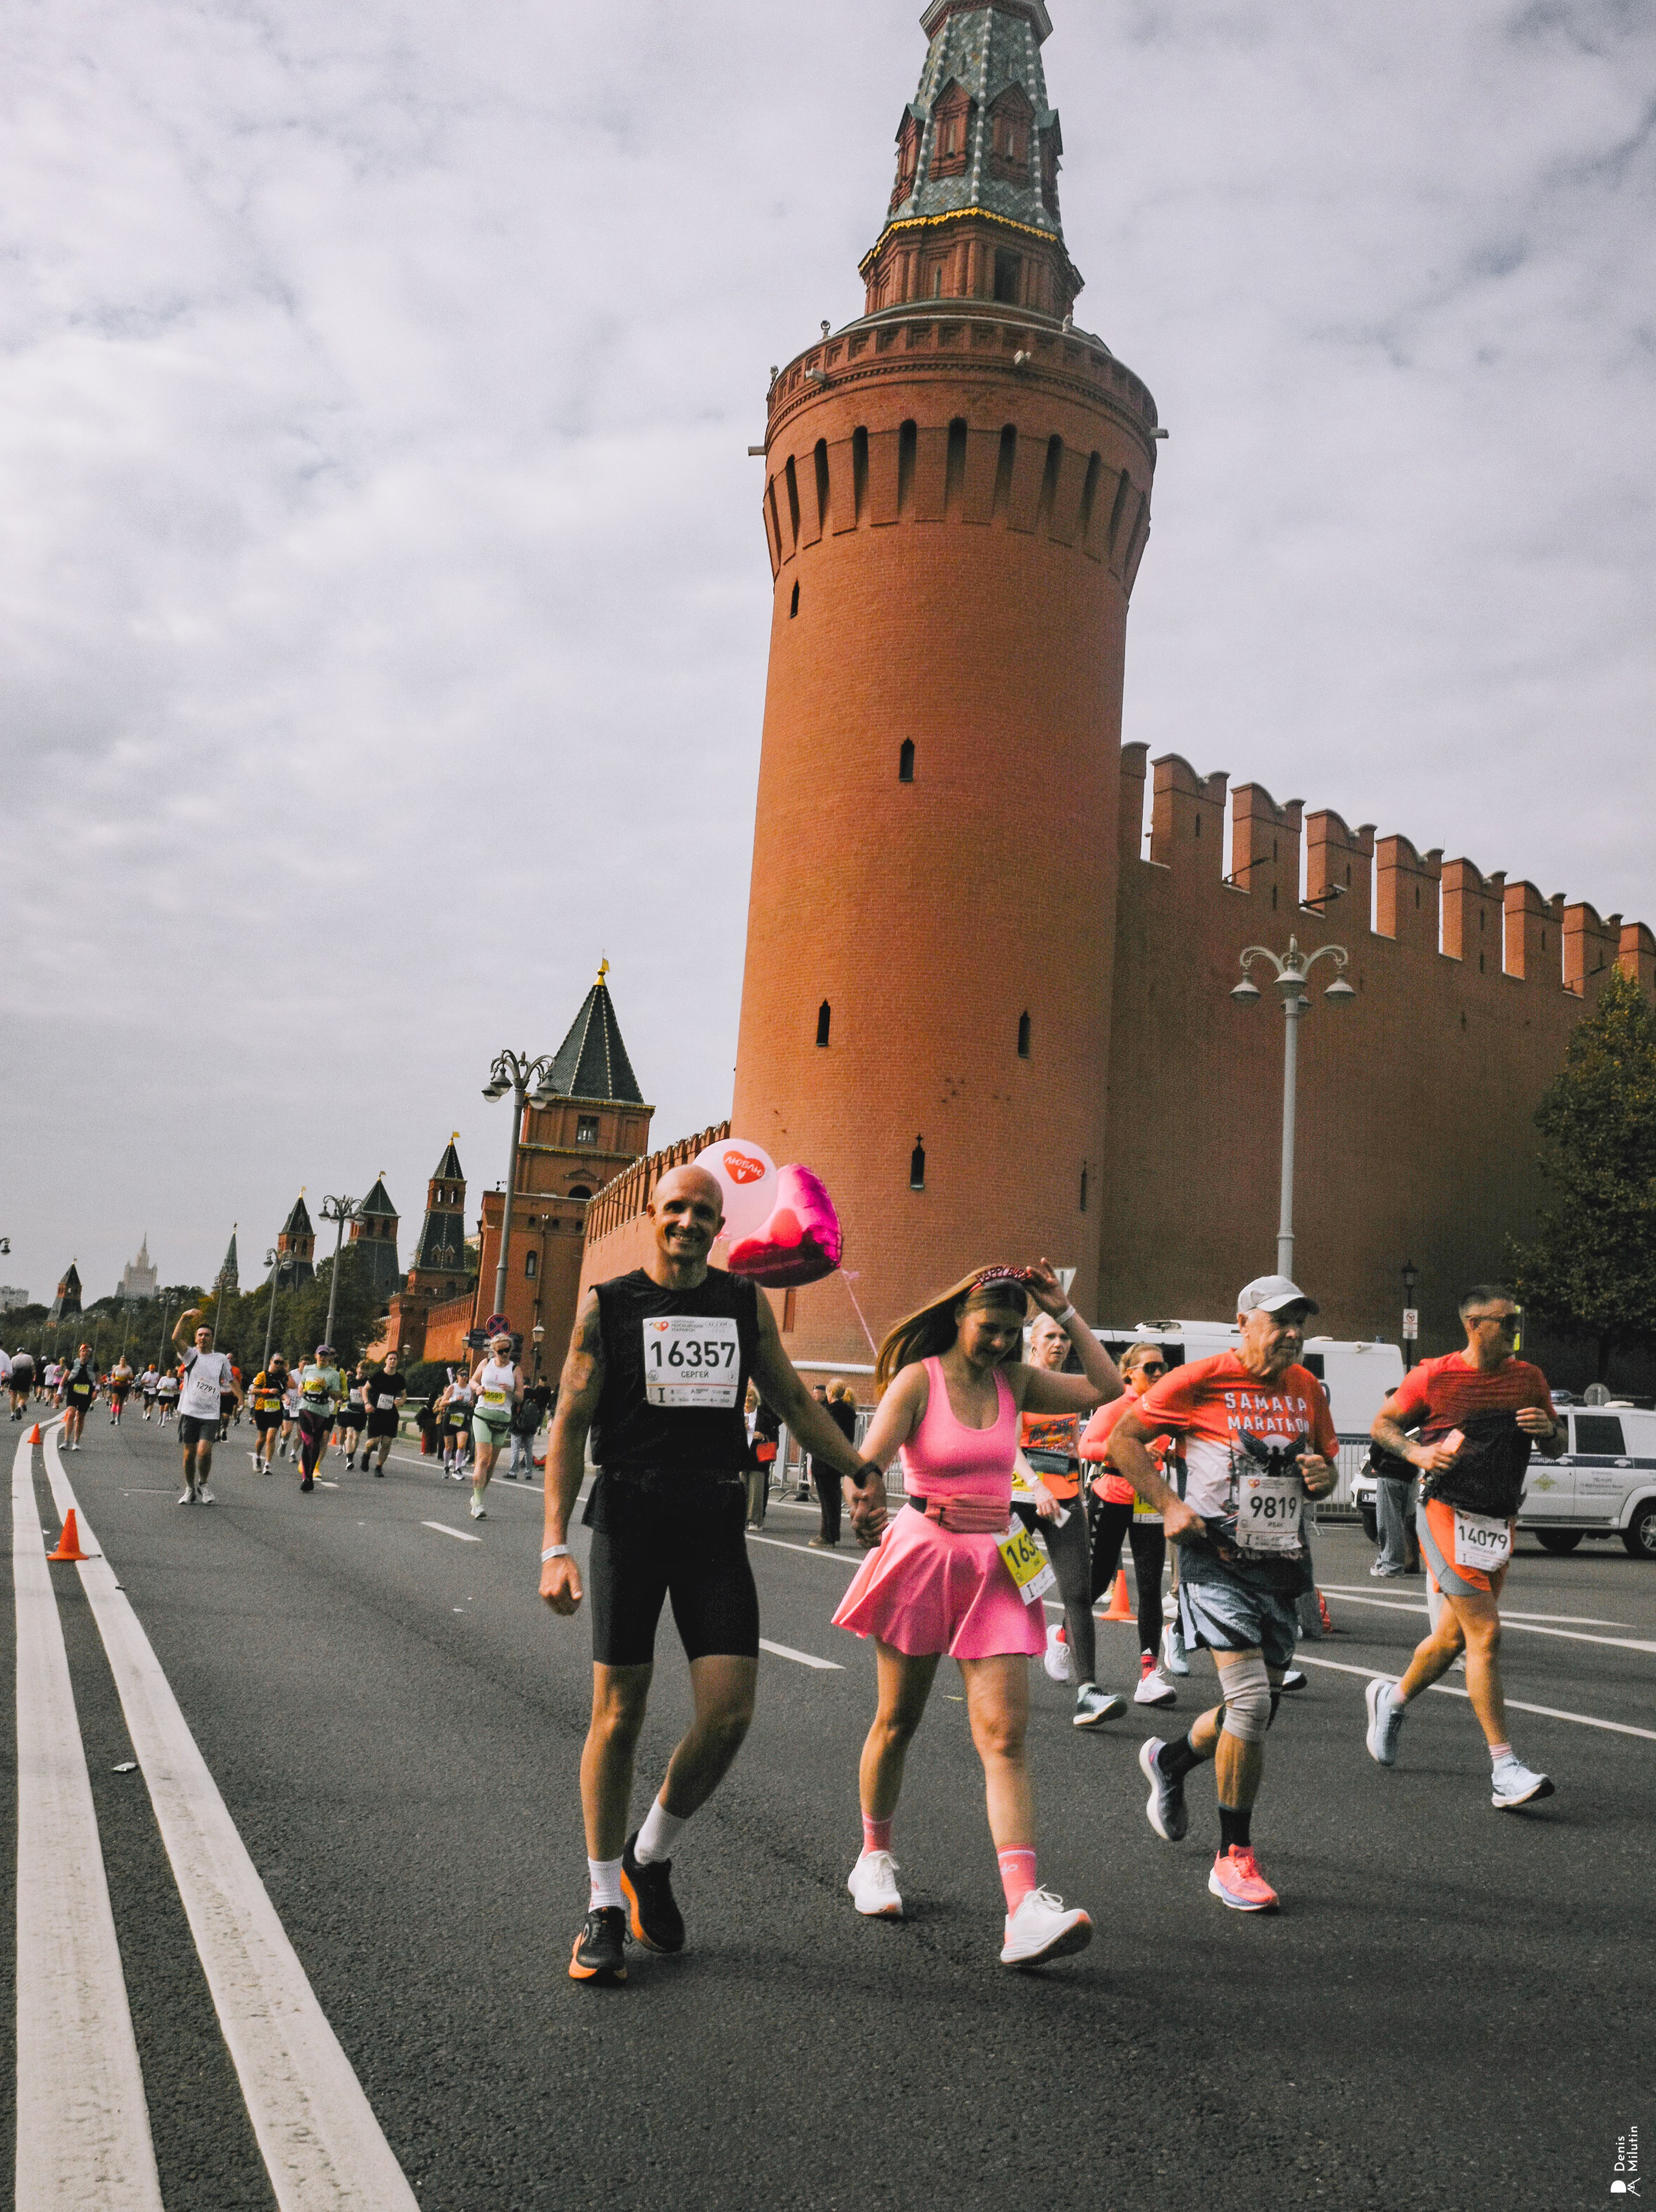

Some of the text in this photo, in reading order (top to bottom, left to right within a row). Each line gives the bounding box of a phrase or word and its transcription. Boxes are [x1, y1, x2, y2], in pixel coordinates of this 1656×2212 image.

[724, 1155, 763, 1177] ЛЮБЛЮ
[975, 1265, 1007, 1284] HAPPY
[651, 1341, 736, 1368] 16357
[681, 1370, 709, 1379] СЕРГЕЙ
[197, 1381, 216, 1394] 12791
[1225, 1392, 1307, 1412] SAMARA
[1227, 1416, 1310, 1432] MARATHON
[1250, 1496, 1297, 1519] 9819
[1459, 1525, 1508, 1549] 14079
[1006, 1533, 1040, 1568] 163
